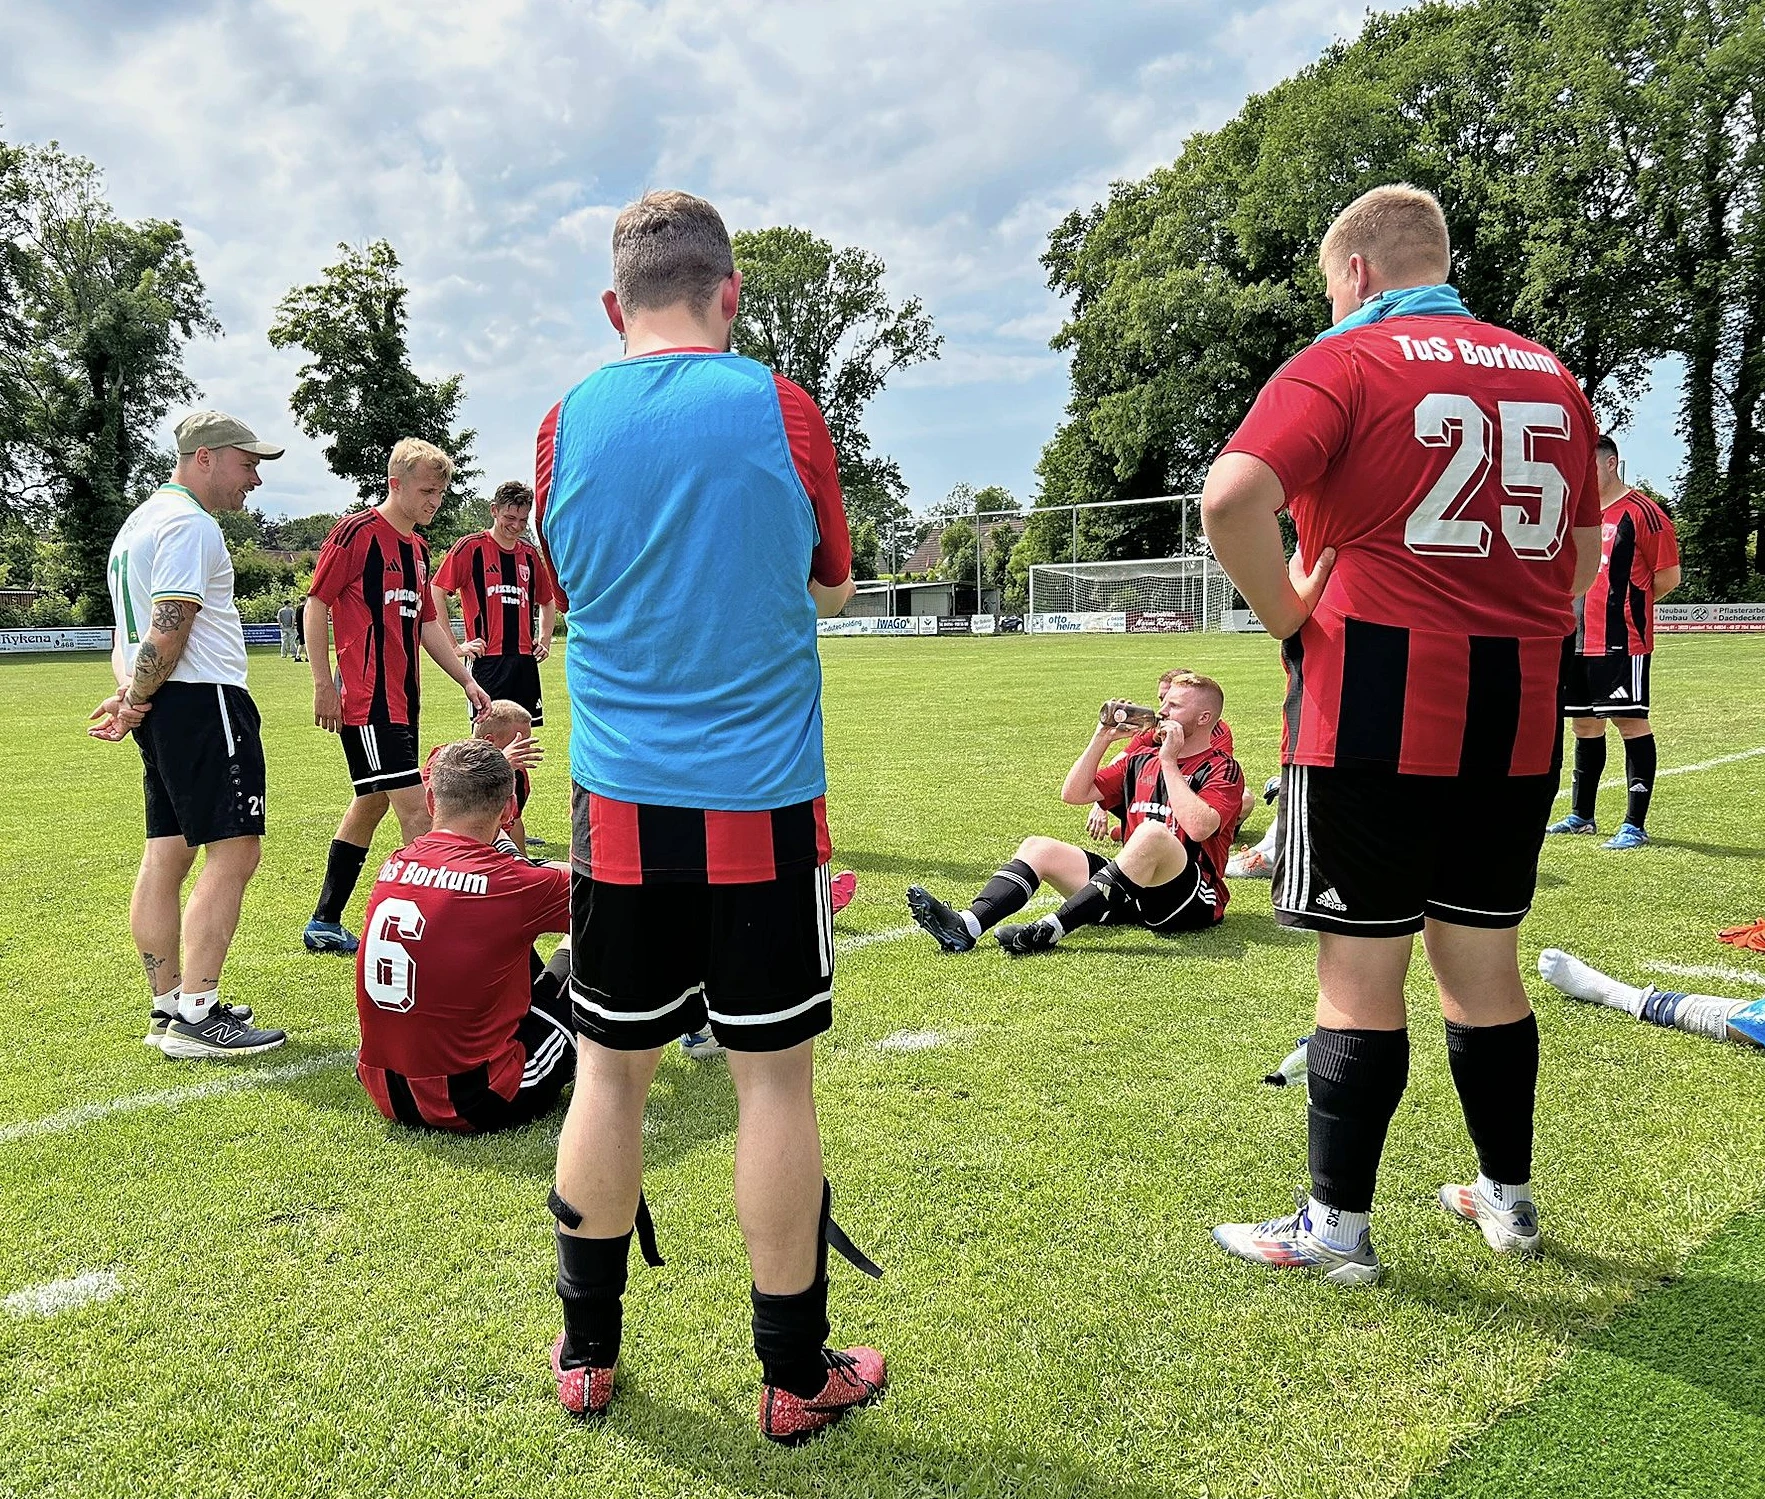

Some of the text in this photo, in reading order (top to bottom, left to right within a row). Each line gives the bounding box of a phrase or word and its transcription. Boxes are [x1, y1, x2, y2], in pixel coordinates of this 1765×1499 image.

[1391, 335, 1561, 376] TuS Borkum
[1404, 393, 1571, 561] 25
[1048, 615, 1067, 623] otto
[1056, 622, 1081, 630] heinz
[248, 795, 264, 816] 21
[399, 861, 489, 895] Borkum
[1315, 897, 1348, 911] adidas
[364, 897, 427, 1013] 6
